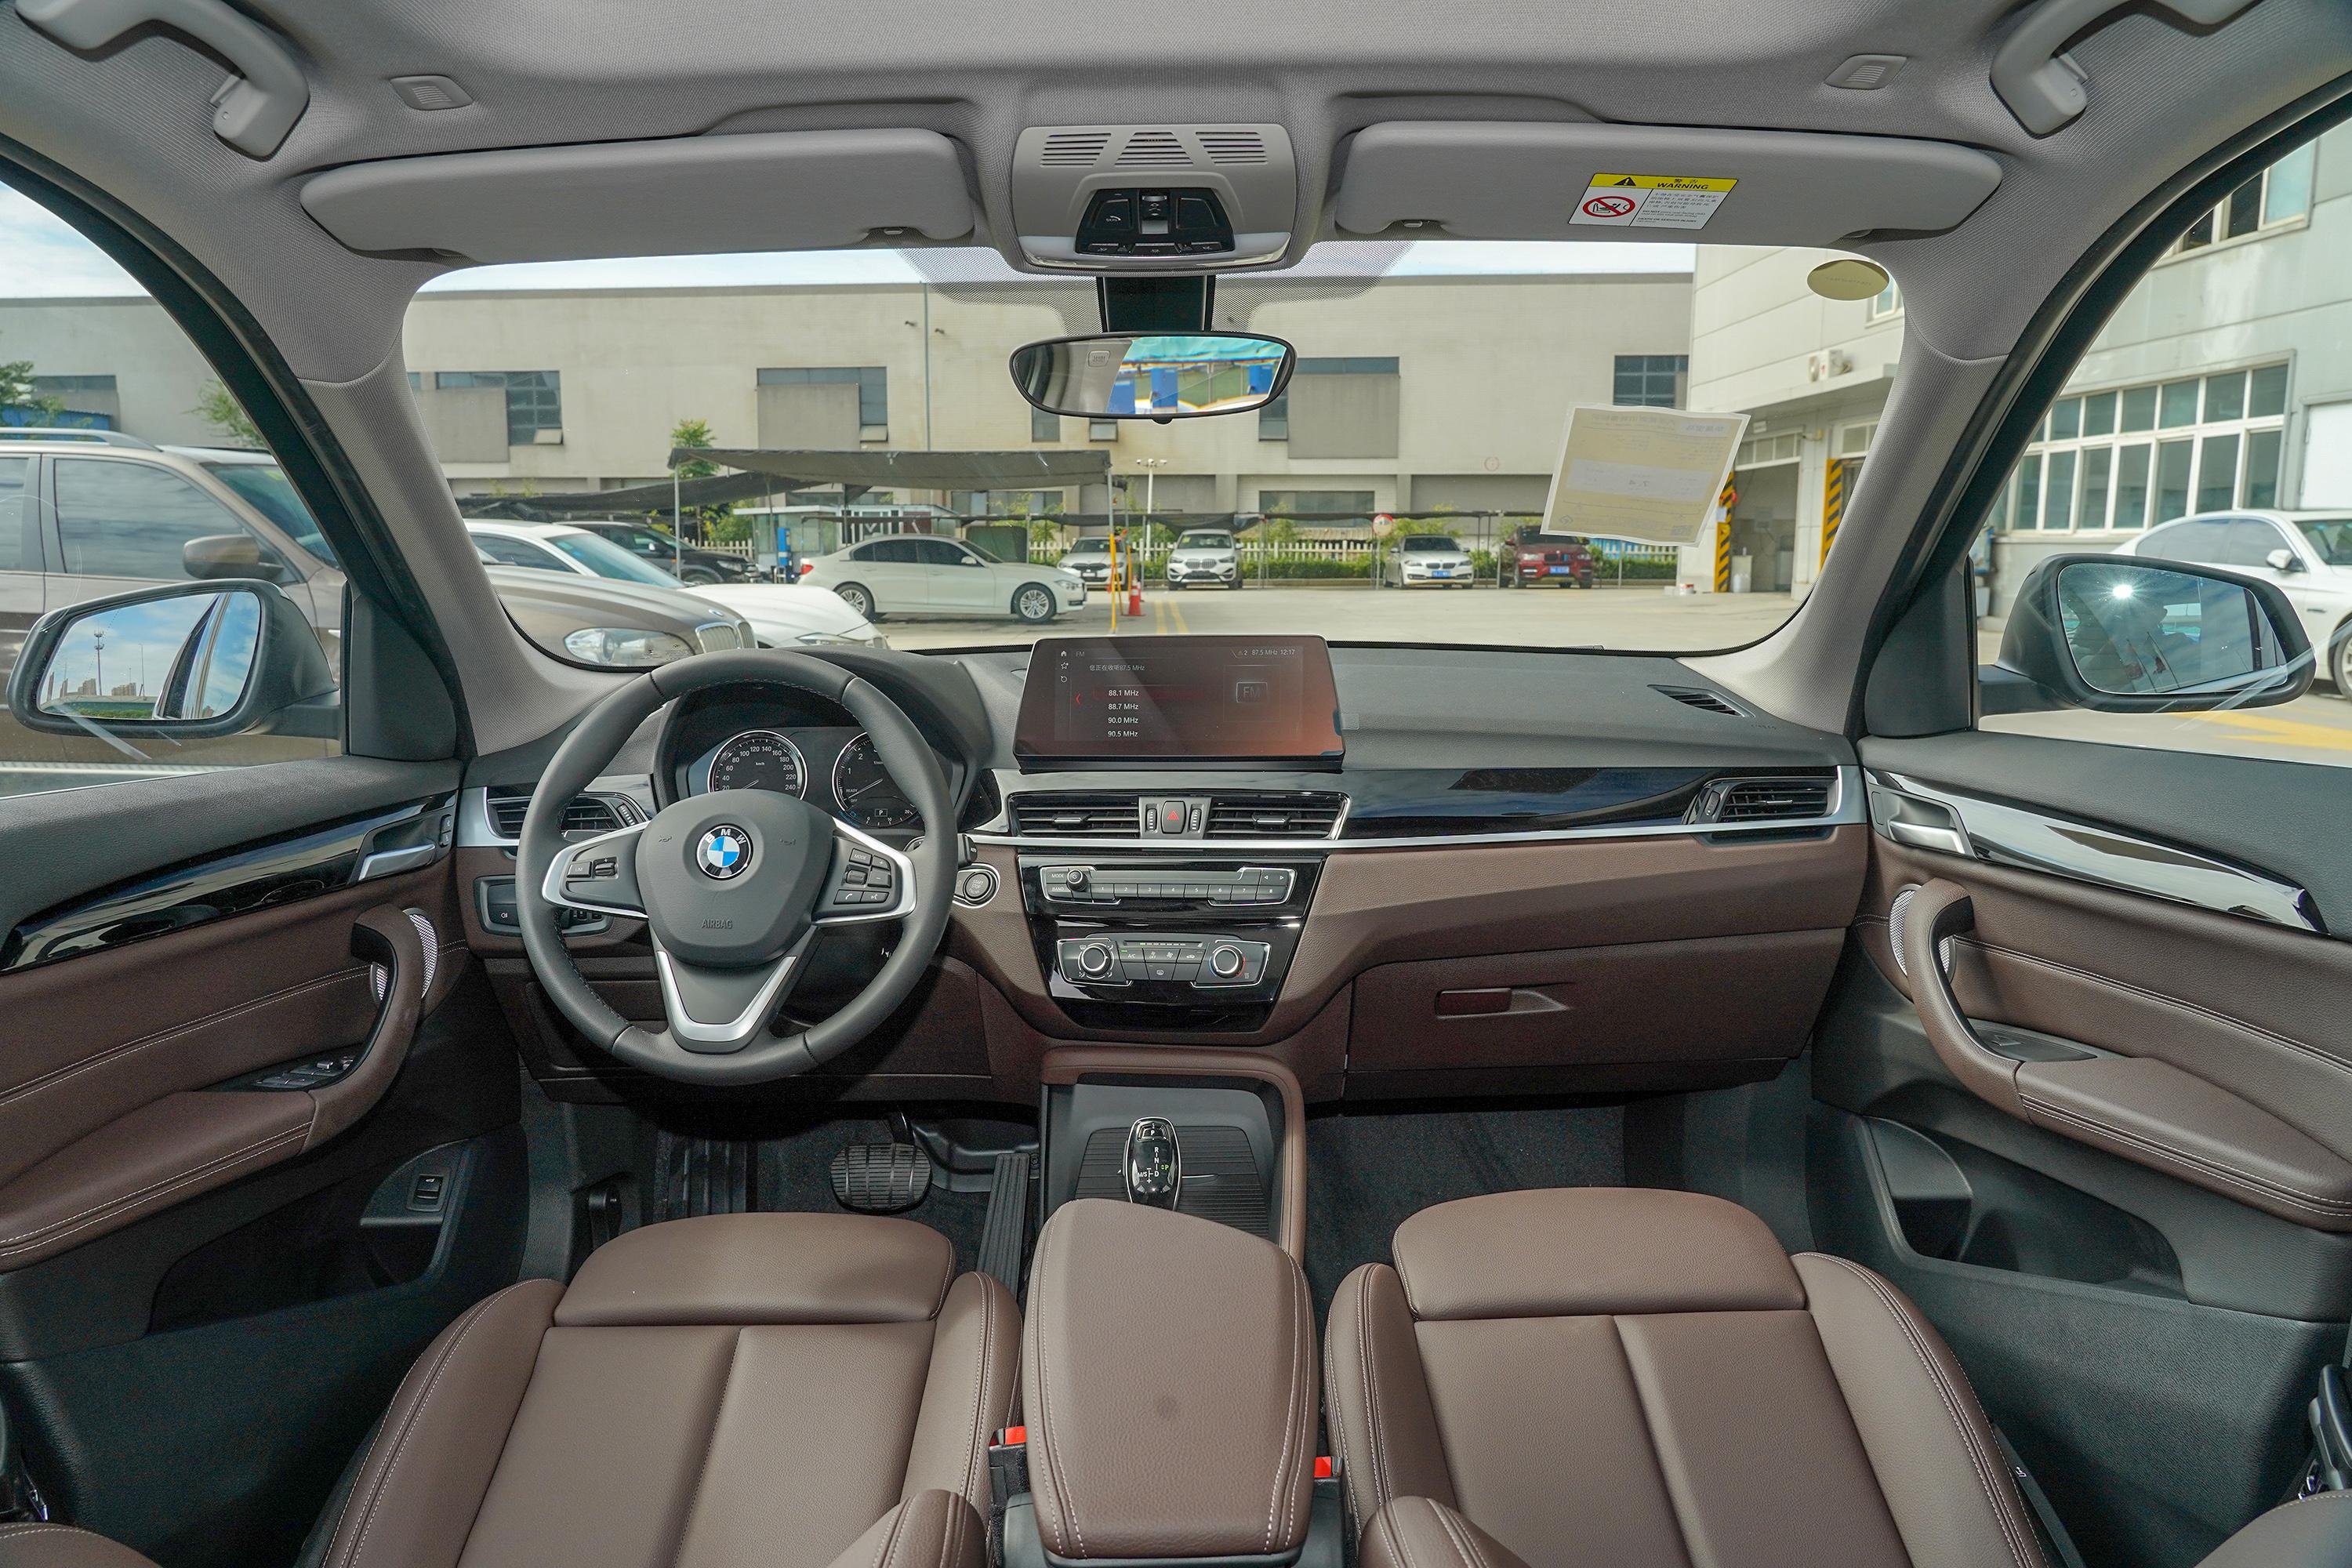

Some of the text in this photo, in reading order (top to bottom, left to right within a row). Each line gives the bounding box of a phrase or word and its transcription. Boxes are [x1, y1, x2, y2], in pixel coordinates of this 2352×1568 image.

[1243, 686, 1261, 698] FM
[705, 828, 747, 844] BMW
[702, 919, 732, 929] AIRBAG
